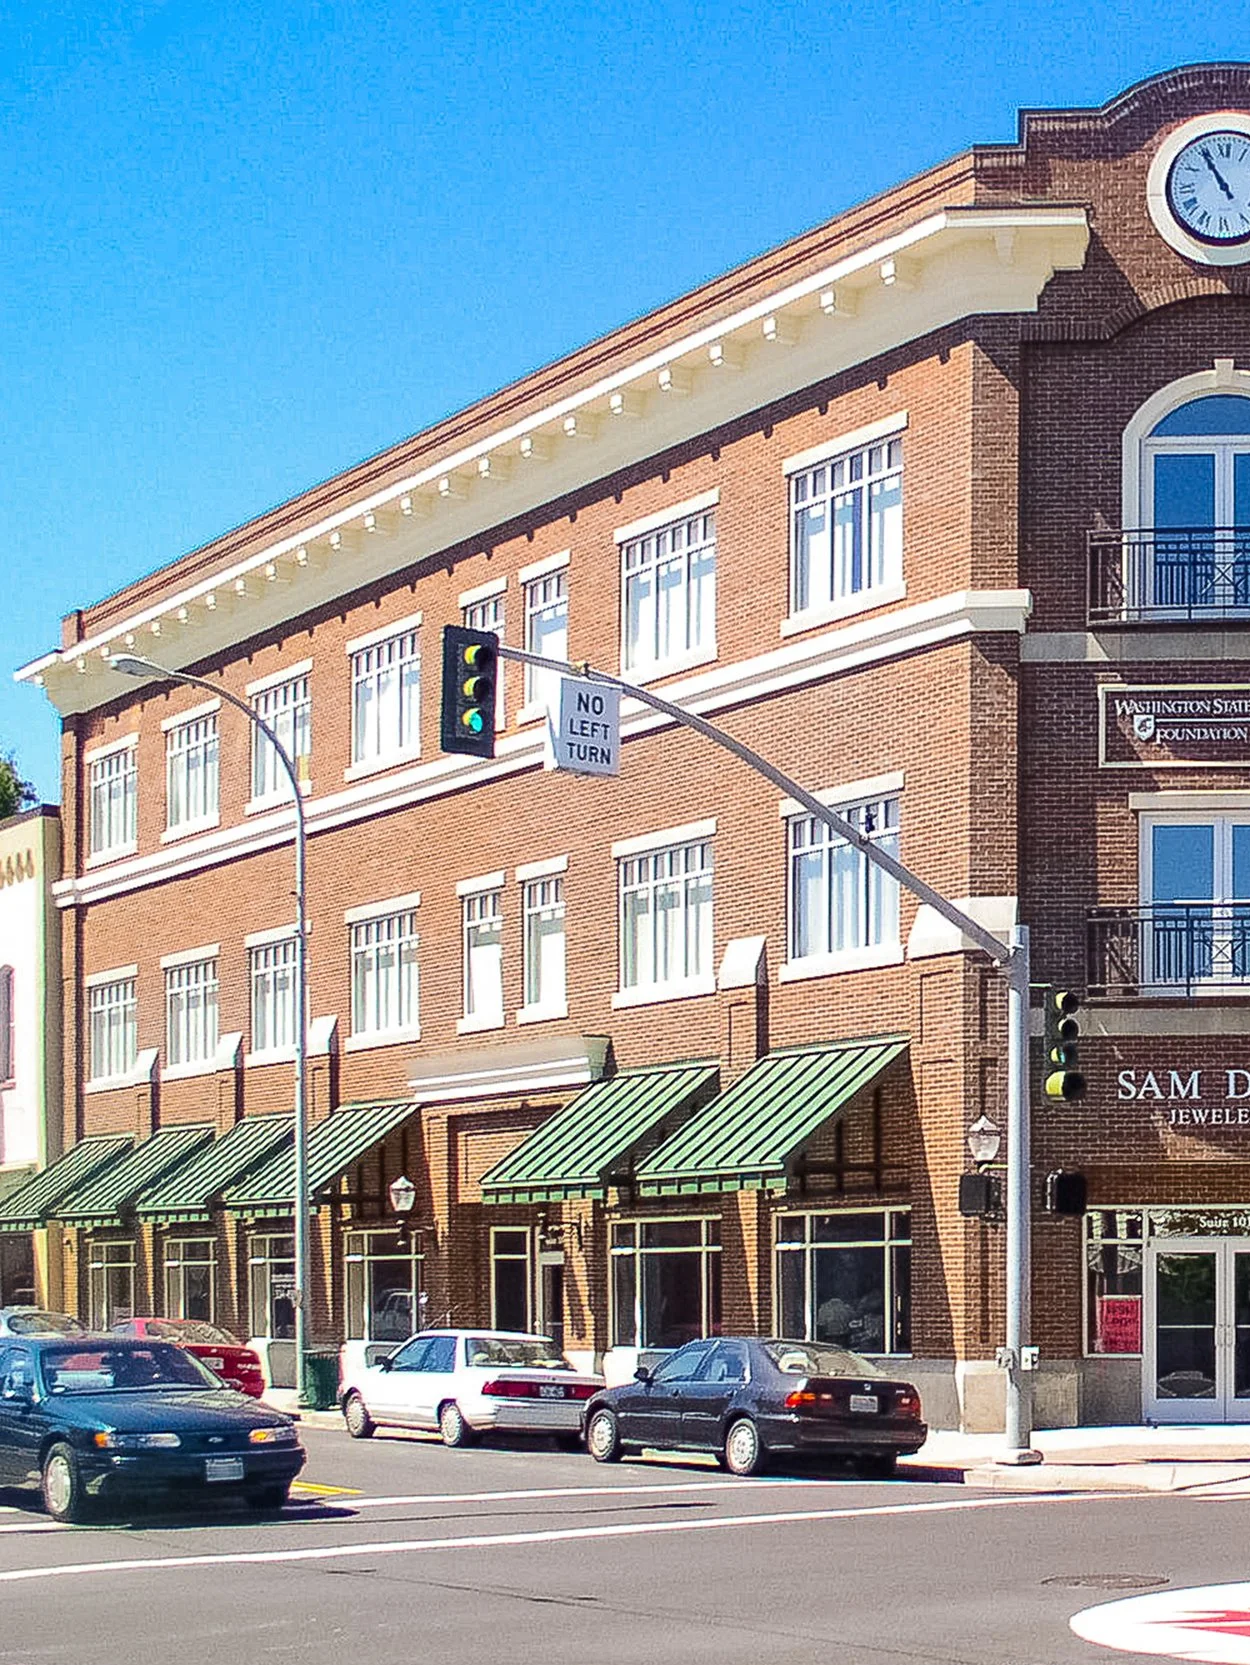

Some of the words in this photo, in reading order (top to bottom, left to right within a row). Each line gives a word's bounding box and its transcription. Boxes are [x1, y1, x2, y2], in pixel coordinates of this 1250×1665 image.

[577, 692, 604, 715] NO
[1114, 699, 1211, 716] WASHINGTON
[569, 718, 610, 740] LEFT
[1156, 726, 1248, 743] FOUNDATION
[566, 742, 611, 764] TURN
[1118, 1069, 1202, 1100] SAM
[1199, 1216, 1229, 1228] Suite
